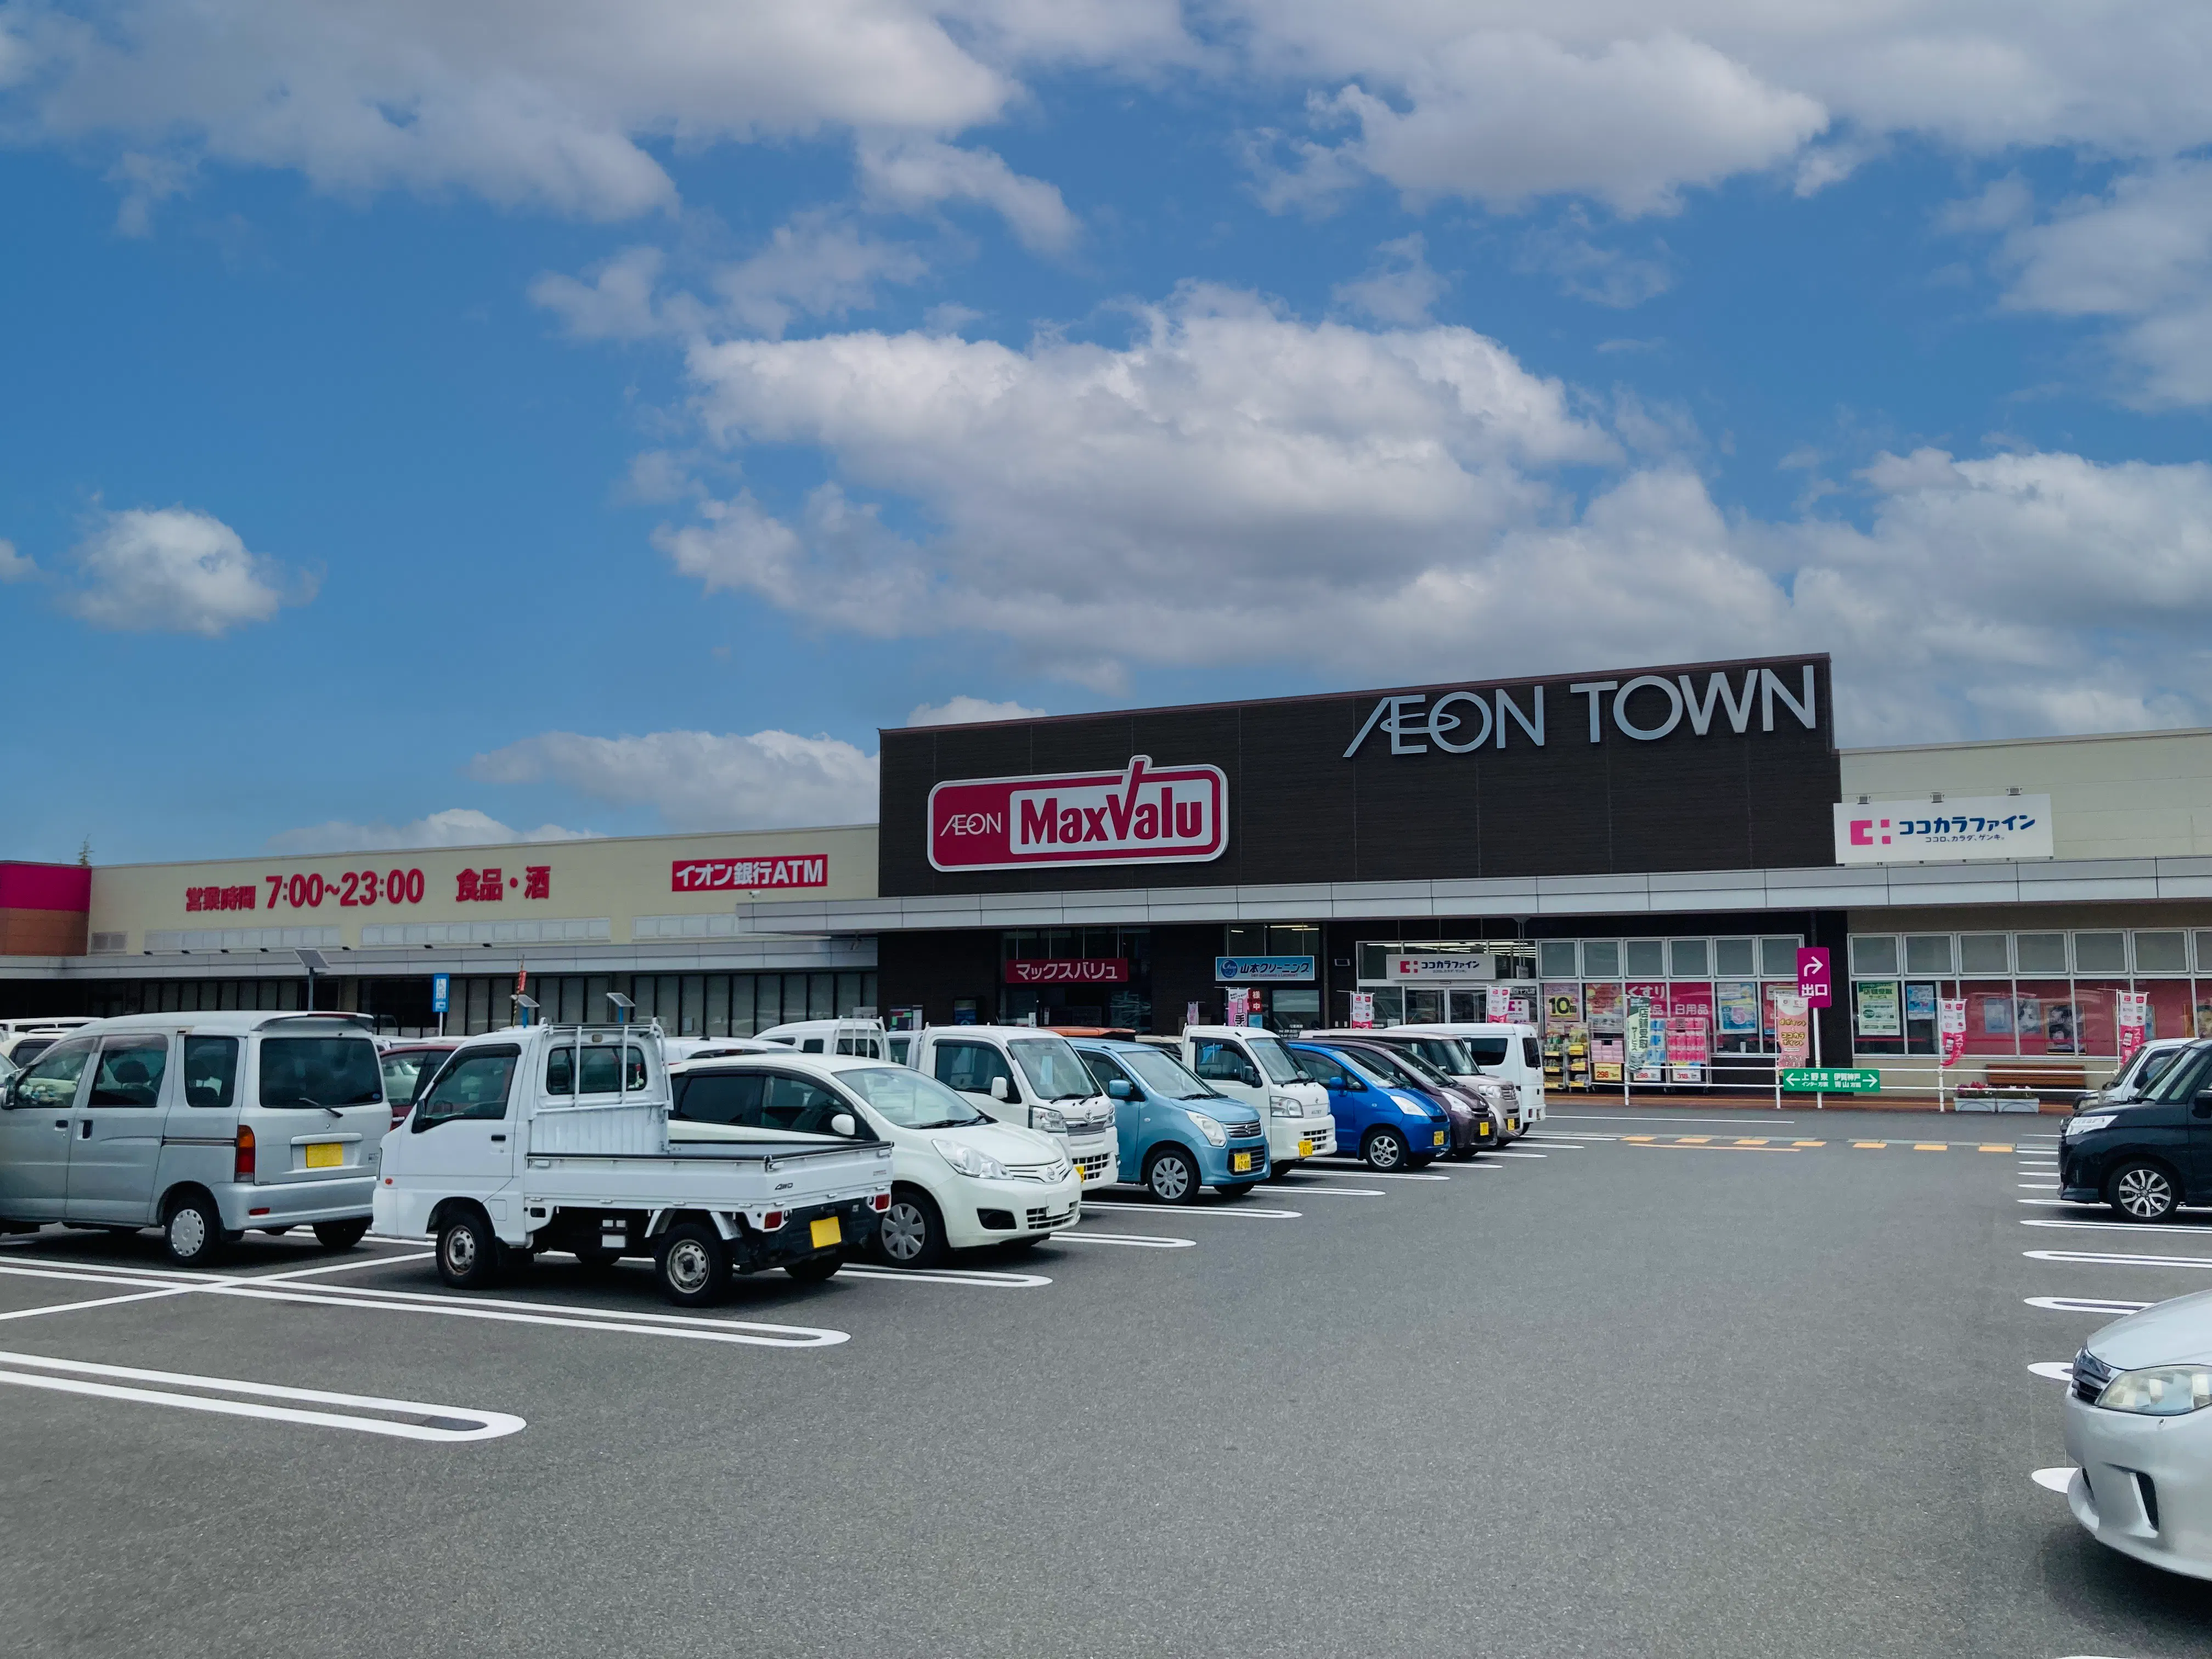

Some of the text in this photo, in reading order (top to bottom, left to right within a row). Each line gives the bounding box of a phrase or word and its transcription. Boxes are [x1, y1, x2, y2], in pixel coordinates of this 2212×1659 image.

[1570, 665, 1816, 743] TOWN
[1021, 760, 1203, 845] MaxValu
[1899, 814, 2035, 835] ココカラファイン
[675, 859, 824, 887] イオン銀行ATM
[185, 885, 256, 912] 営業時間
[455, 866, 551, 901] 食品・酒
[1015, 962, 1118, 981] マックスバリュ
[1240, 962, 1310, 974] 山本クリーニング
[1421, 960, 1480, 969] ココカラファイン
[1628, 985, 1666, 999] くすり
[1801, 983, 1828, 997] 出口
[1675, 1003, 1709, 1015] 日用品
